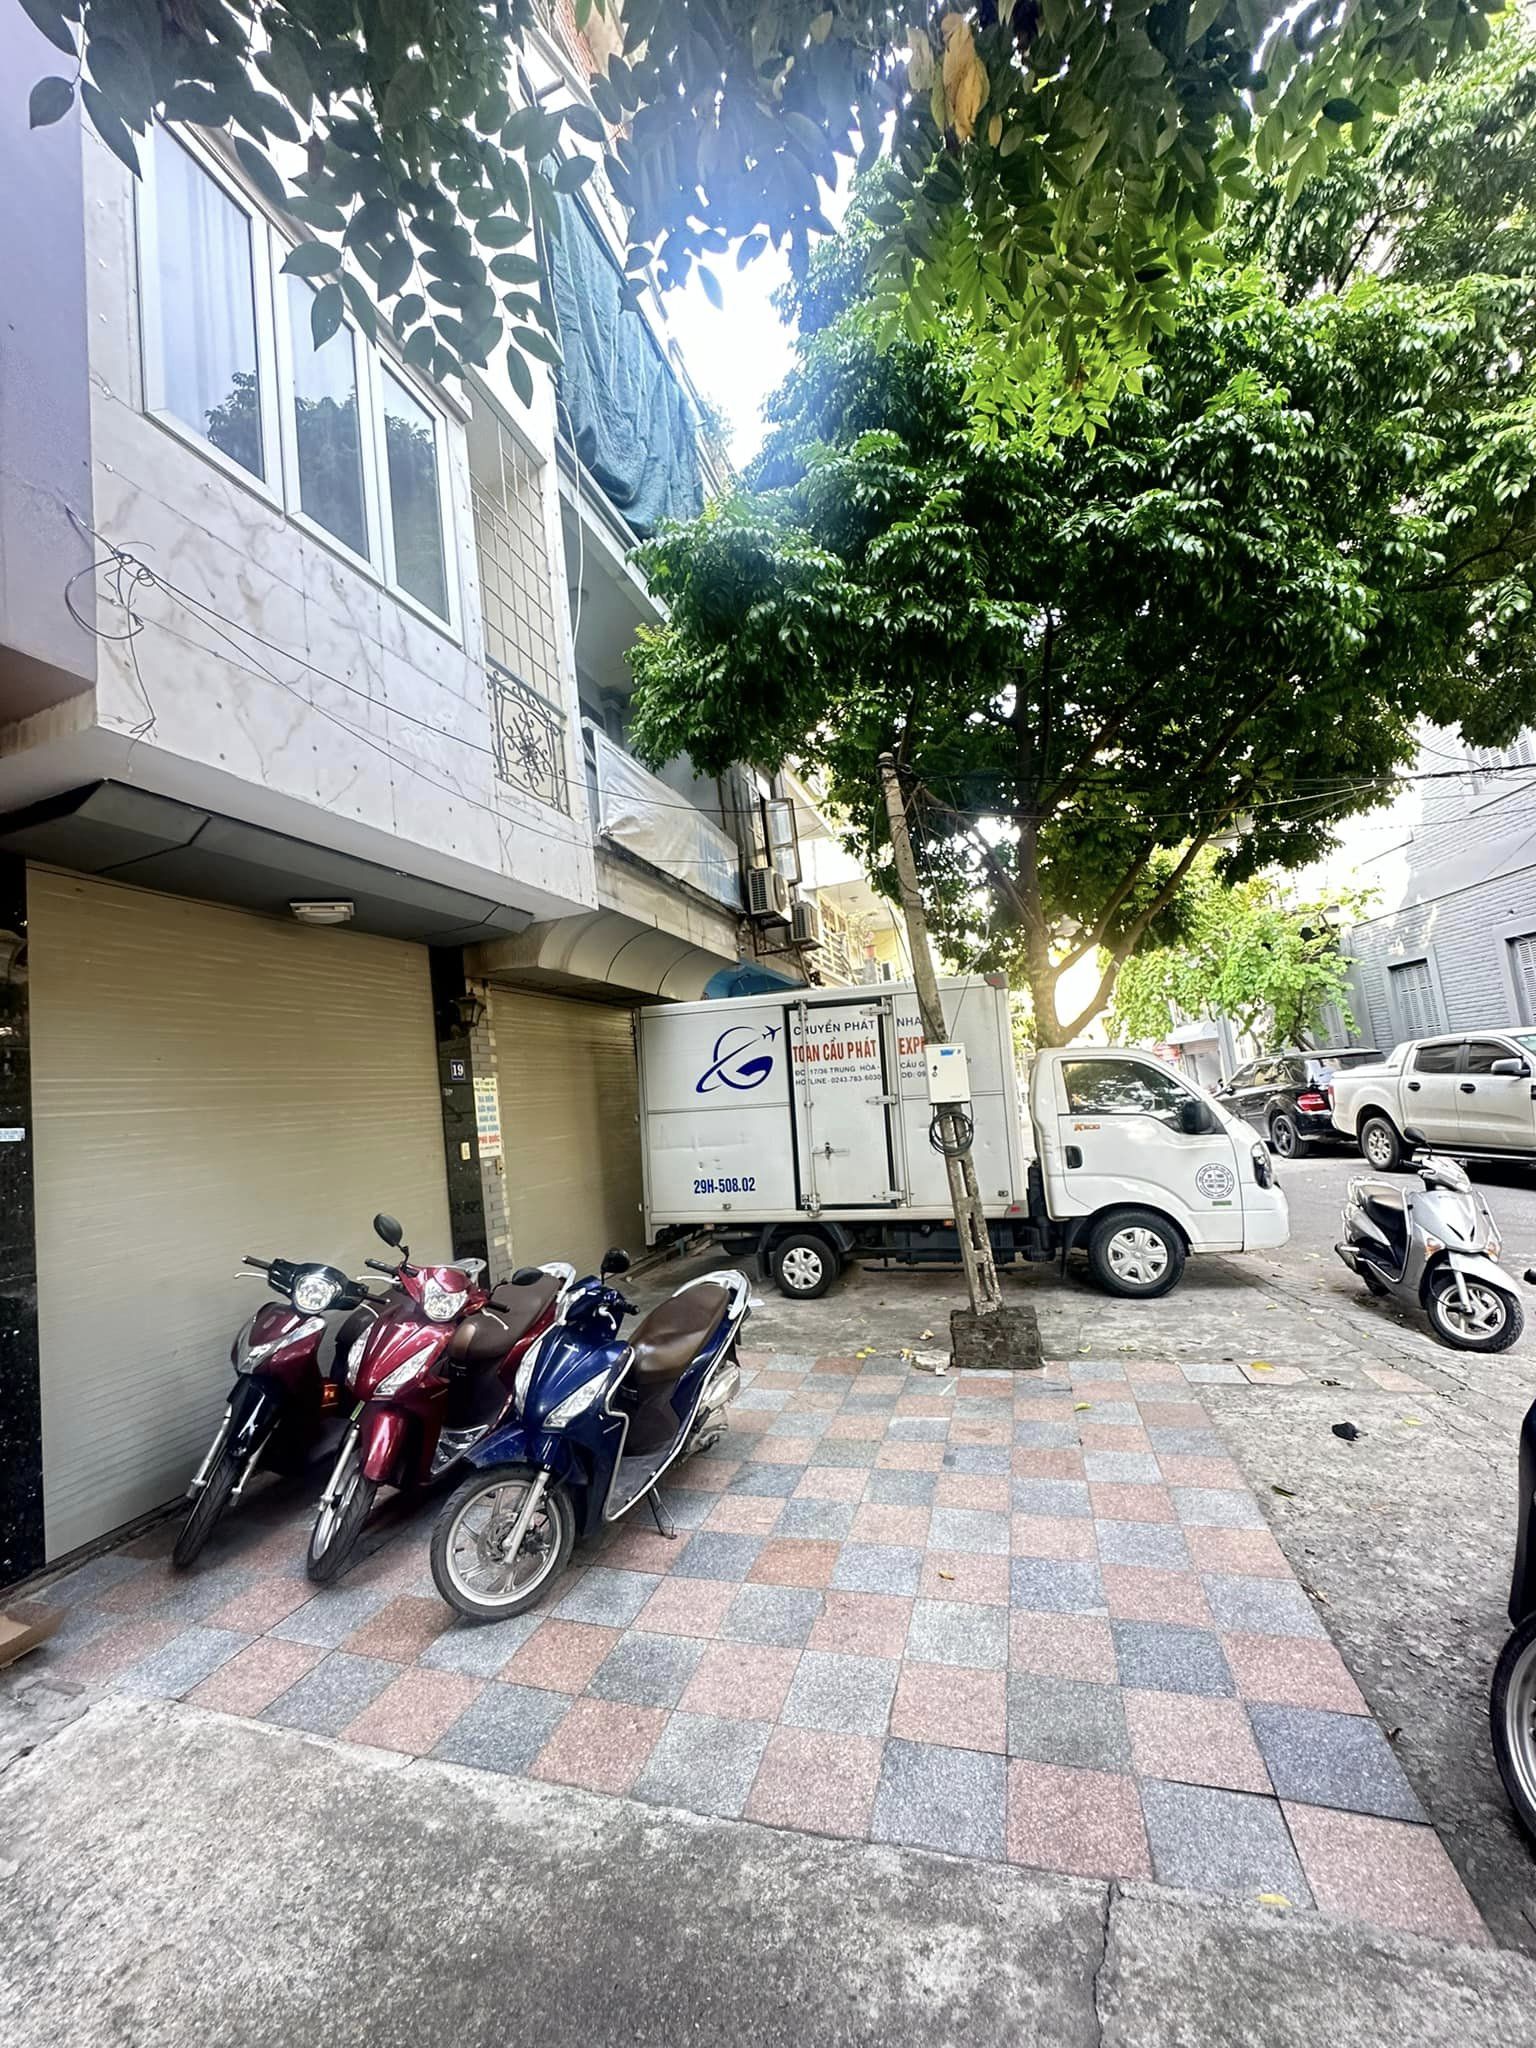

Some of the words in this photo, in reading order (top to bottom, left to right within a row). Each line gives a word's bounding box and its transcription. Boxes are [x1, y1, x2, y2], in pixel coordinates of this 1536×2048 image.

[844, 1018, 875, 1032] PHÁT
[897, 1016, 922, 1027] NHA
[792, 1041, 820, 1063] TOÀN
[847, 1036, 876, 1059] PHÁT
[452, 1064, 464, 1077] 19
[830, 1065, 856, 1073] TRUNG
[693, 1176, 756, 1194] 29H-508.02
